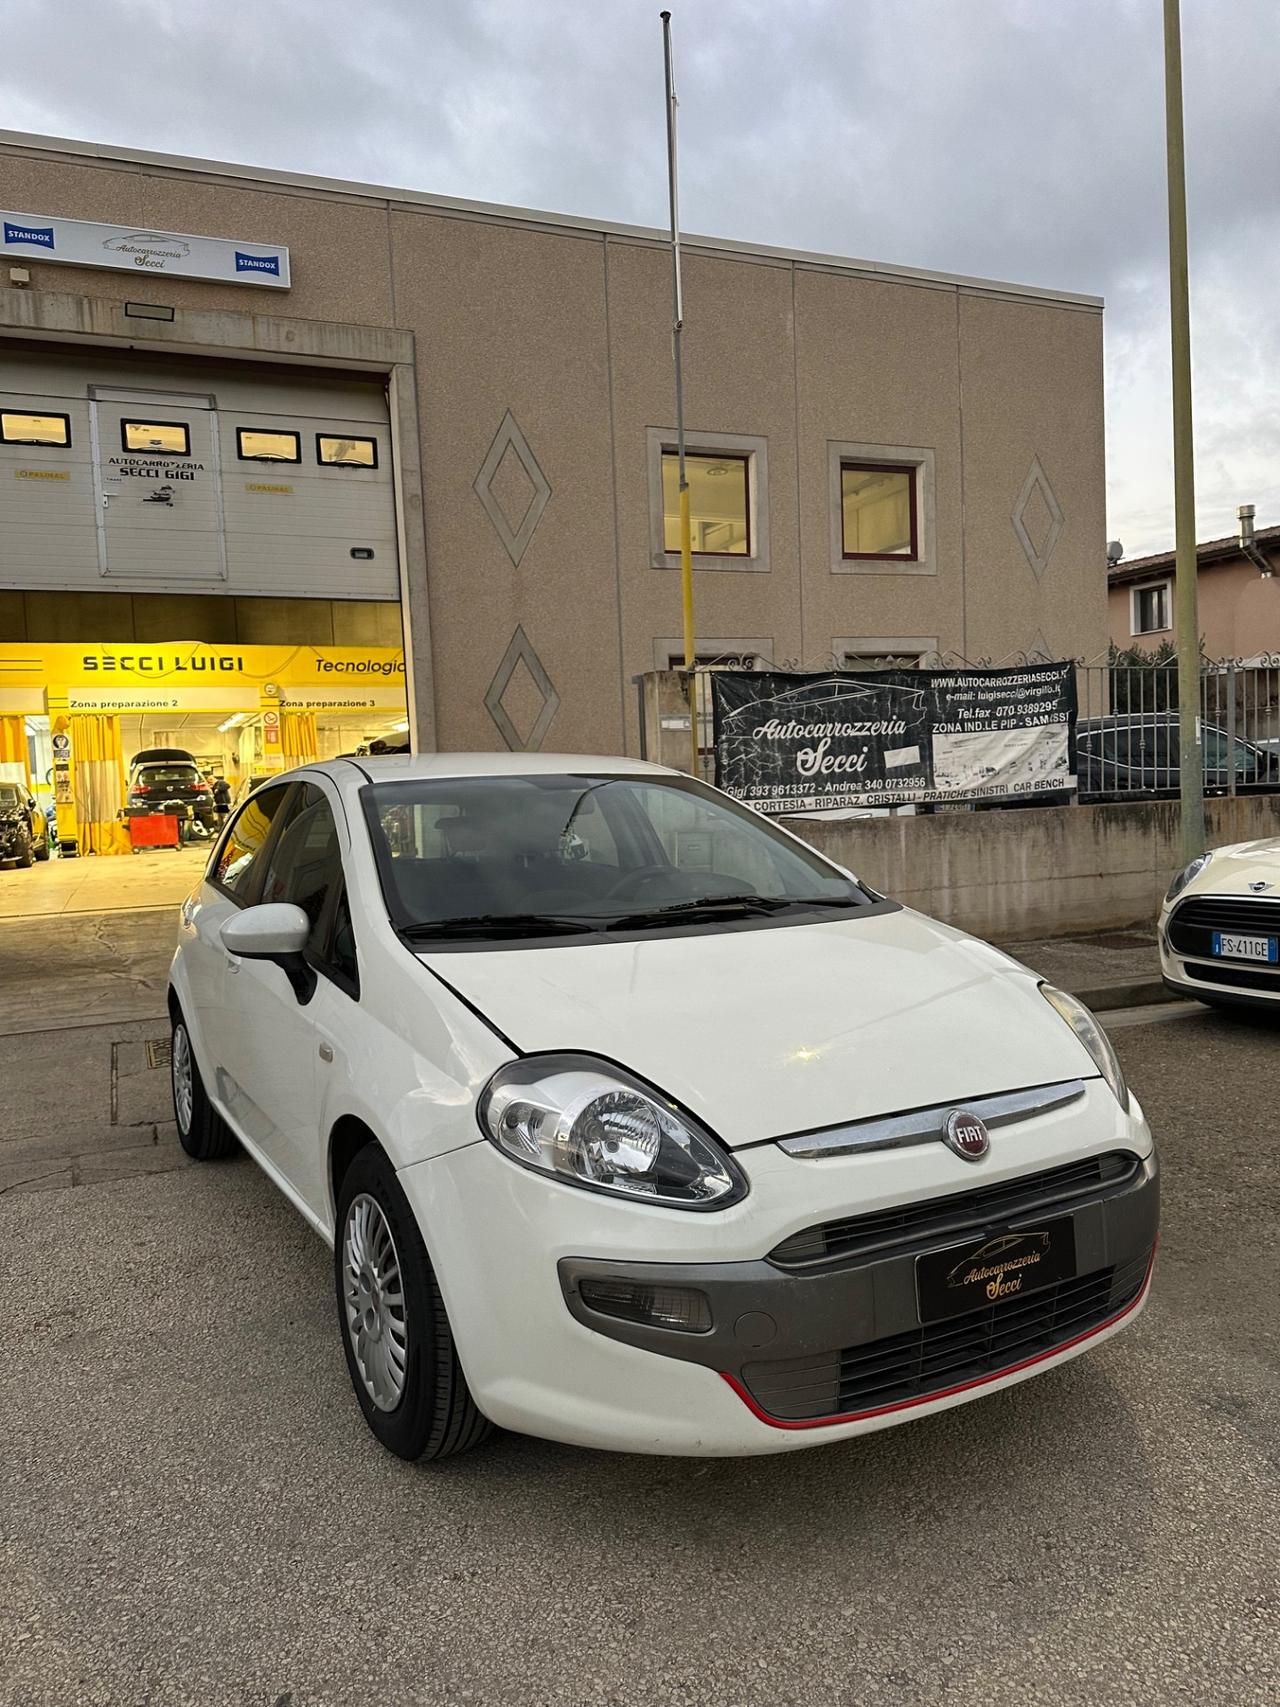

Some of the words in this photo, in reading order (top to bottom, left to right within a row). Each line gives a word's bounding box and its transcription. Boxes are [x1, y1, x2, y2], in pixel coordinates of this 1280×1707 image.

[8, 230, 50, 242] STANDOX
[115, 244, 181, 258] Autocarrozzeria
[134, 255, 166, 268] Secci
[239, 258, 276, 269] STANDOX
[120, 467, 159, 478] SECCI
[165, 470, 194, 480] GIGI
[83, 656, 163, 671] SECCI
[175, 657, 243, 671] LUIGI
[946, 691, 976, 700] e-mail:
[70, 700, 97, 708] Zona
[100, 700, 169, 709] preparazione
[172, 699, 178, 707] 2
[306, 699, 367, 708] preparazione
[957, 707, 991, 719] Tel.fax
[996, 705, 1015, 717] 070
[1017, 700, 1058, 715] 9389295
[753, 715, 907, 740] Autocarrozzeria
[932, 723, 962, 734] ZONA
[964, 720, 998, 732] IND.LE
[1001, 718, 1017, 729] PIP
[796, 738, 868, 776] Secci
[726, 785, 747, 799] Gigi
[750, 785, 769, 796] 393
[771, 782, 815, 796] 9613372
[825, 780, 862, 792] Andrea
[865, 779, 883, 790] 340
[885, 777, 926, 789] 0732956
[753, 799, 806, 812] CORTESIA
[815, 795, 864, 808] RIPARAZ.
[866, 792, 916, 805] CRISTALLI
[923, 788, 972, 801] PRATICHE
[971, 785, 1008, 797] SINISTRI
[1013, 781, 1032, 792] CAR
[1034, 778, 1064, 791] BENCH
[956, 1125, 983, 1143] FIAT
[963, 1250, 1041, 1285] Autocarrozzeria
[986, 1272, 1023, 1299] Secci
